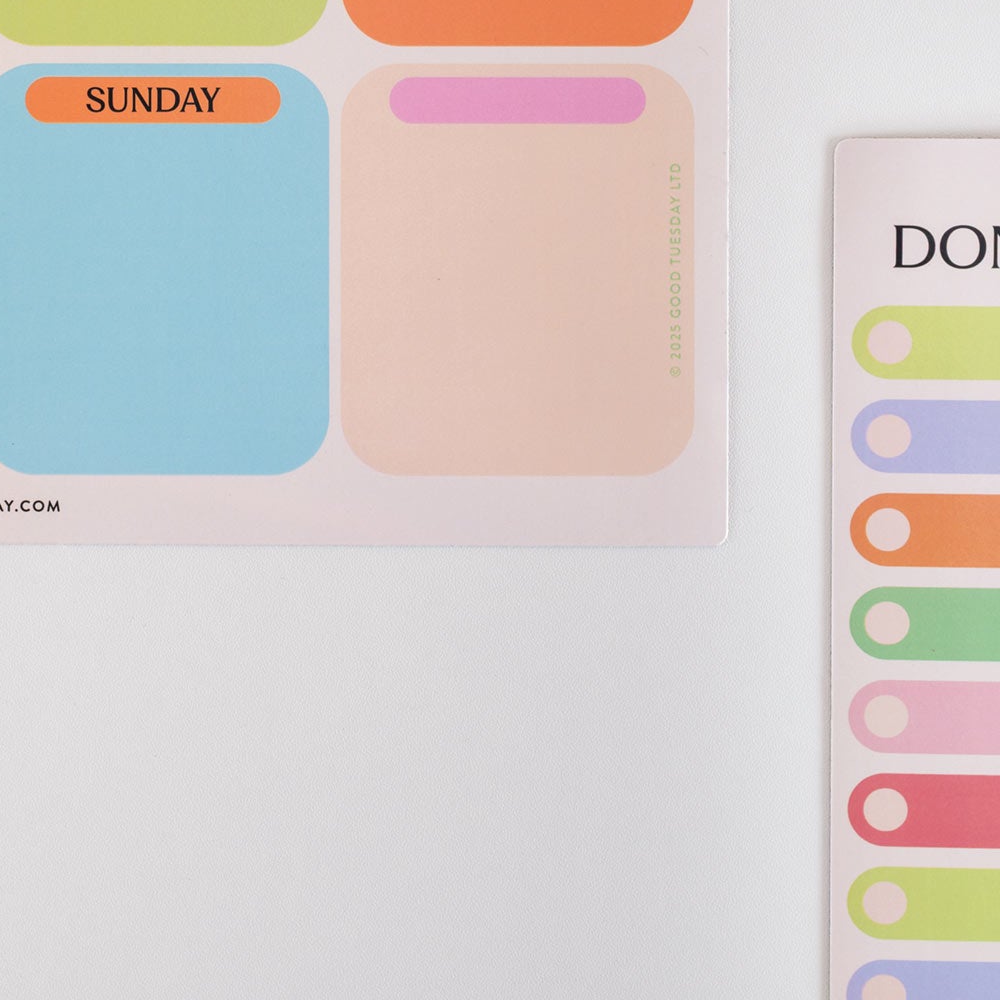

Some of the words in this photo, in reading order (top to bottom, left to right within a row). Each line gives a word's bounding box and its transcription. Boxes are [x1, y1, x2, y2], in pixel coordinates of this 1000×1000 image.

[86, 86, 221, 113] SUNDAY
[669, 163, 682, 190] LTD
[669, 196, 682, 265] TUESDAY
[893, 225, 1000, 269] DO
[669, 271, 682, 319] GOOD
[669, 324, 682, 360] 2025
